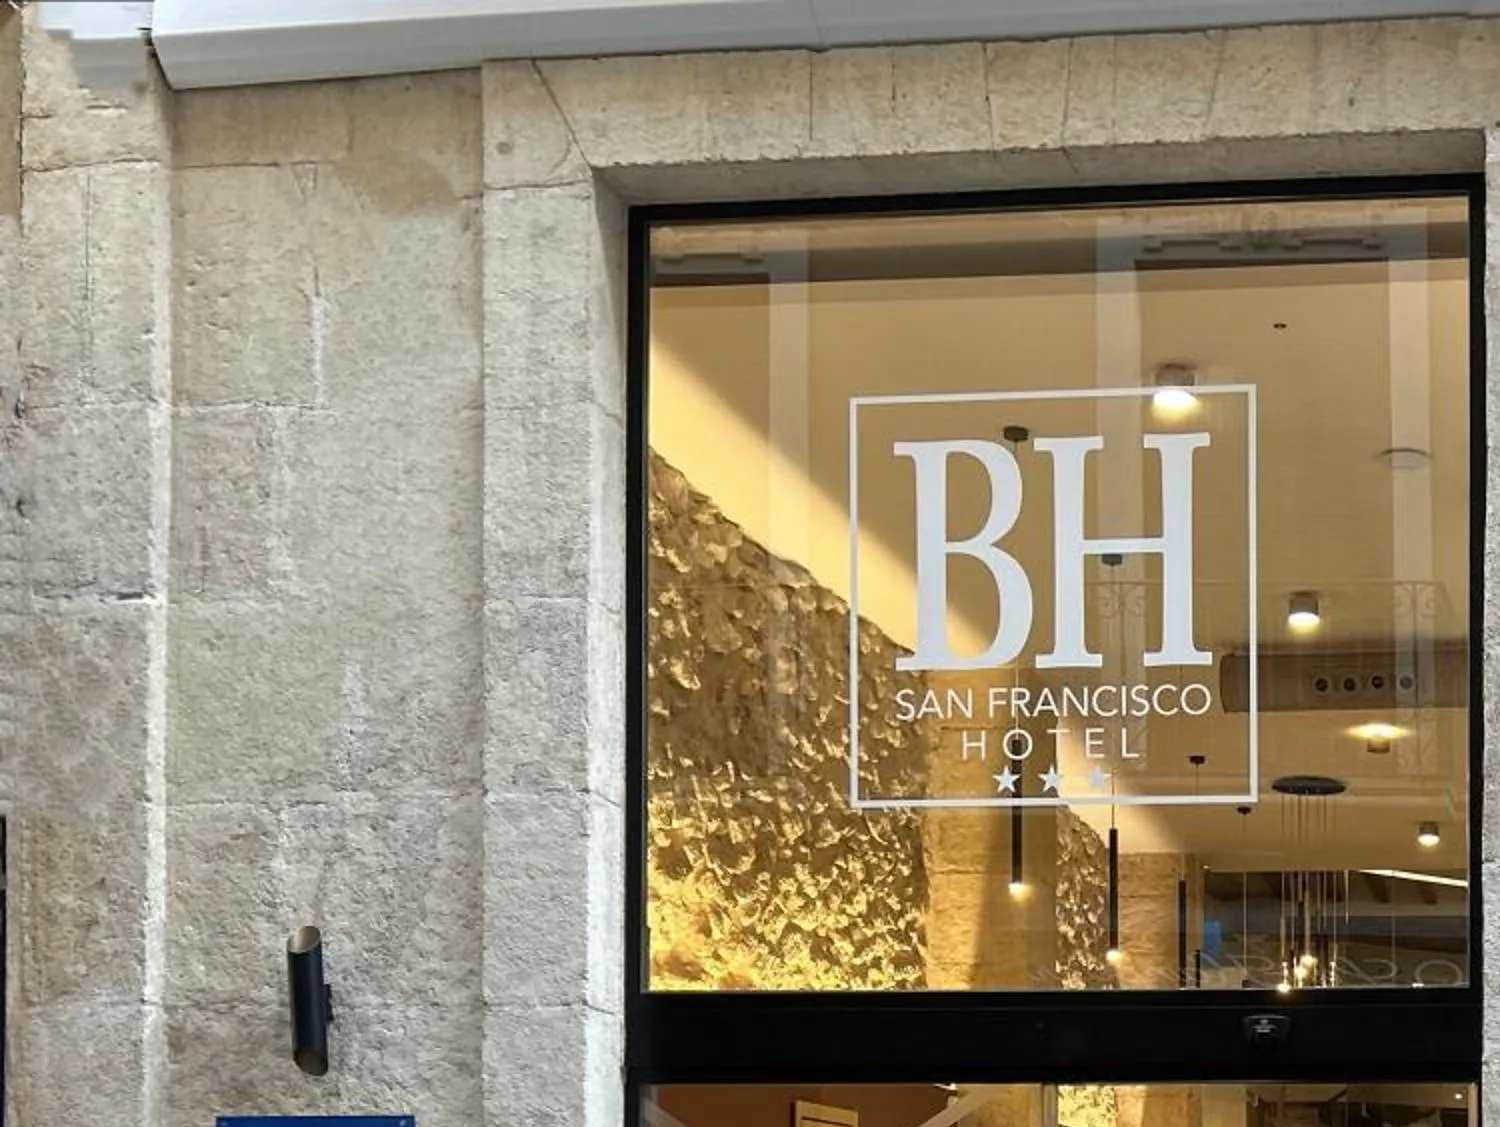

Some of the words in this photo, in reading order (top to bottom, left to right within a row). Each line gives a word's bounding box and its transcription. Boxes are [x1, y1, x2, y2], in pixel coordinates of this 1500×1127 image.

[893, 432, 1213, 671] BH
[895, 688, 973, 721] SAN
[988, 684, 1212, 719] FRANCISCO
[961, 728, 1142, 761] HOTEL
